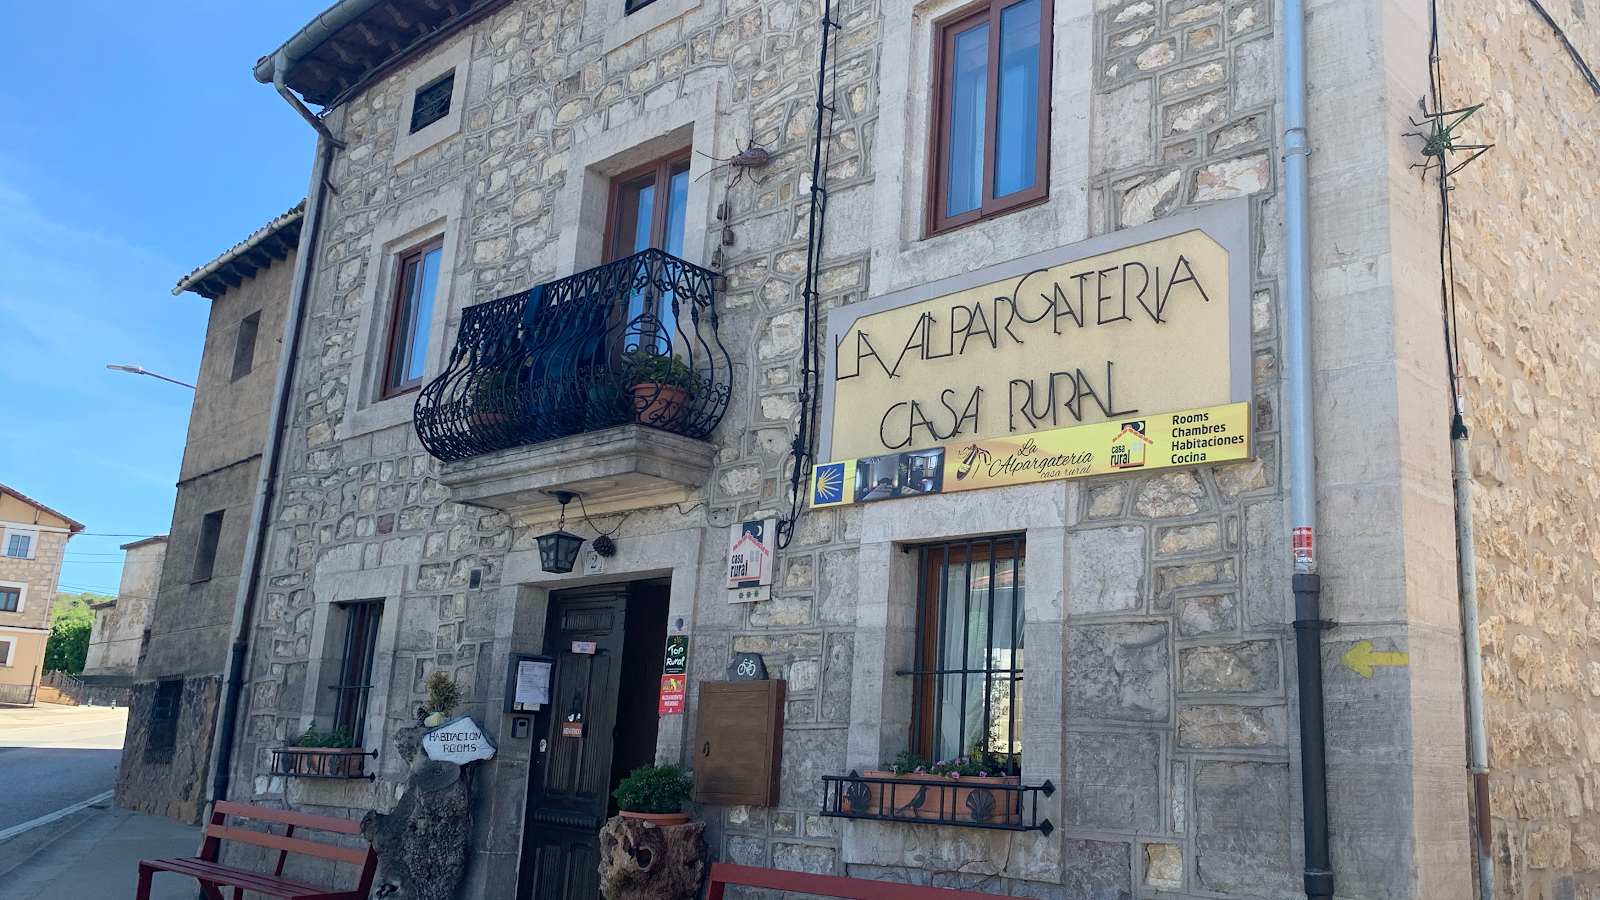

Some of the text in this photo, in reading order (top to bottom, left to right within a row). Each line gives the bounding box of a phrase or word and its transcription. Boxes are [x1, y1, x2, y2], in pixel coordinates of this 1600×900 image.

[835, 254, 1210, 381] LA ALPARGATERIA
[880, 361, 1139, 449] CASA RURAL
[1172, 412, 1209, 425] Rooms
[1172, 423, 1226, 438] Chambres
[1017, 438, 1039, 456] La
[1111, 444, 1126, 454] casa
[1171, 434, 1245, 451] Habitaciones
[1110, 449, 1131, 465] rural
[1171, 452, 1207, 464] Cocina
[1039, 464, 1092, 479] casa rural
[590, 554, 598, 569] 2
[731, 553, 744, 564] casa
[730, 560, 749, 577] rural
[443, 743, 477, 753] ROOMS
